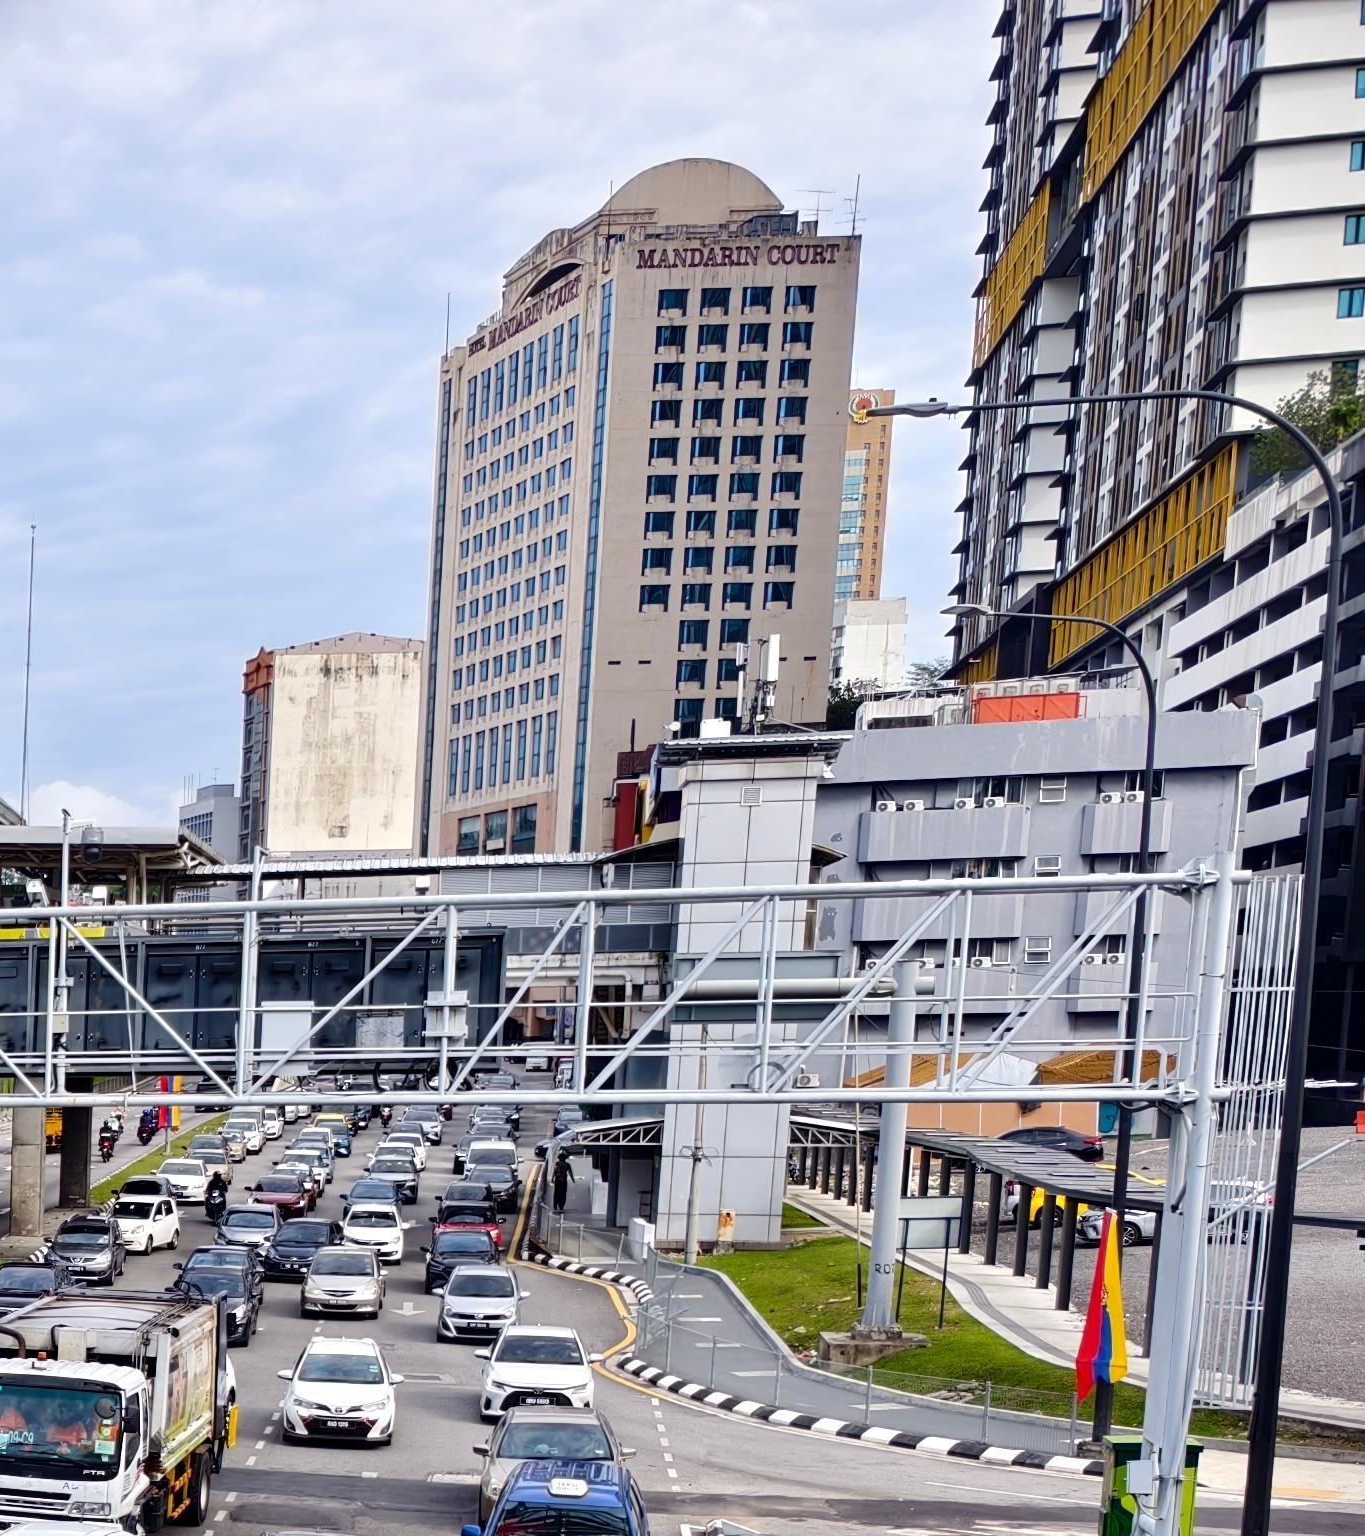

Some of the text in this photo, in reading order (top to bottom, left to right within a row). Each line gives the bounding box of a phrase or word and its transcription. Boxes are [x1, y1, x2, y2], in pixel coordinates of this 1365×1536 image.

[636, 244, 840, 269] MANDARIN COURT
[488, 299, 544, 351] MANDARIN
[546, 274, 582, 316] COURT
